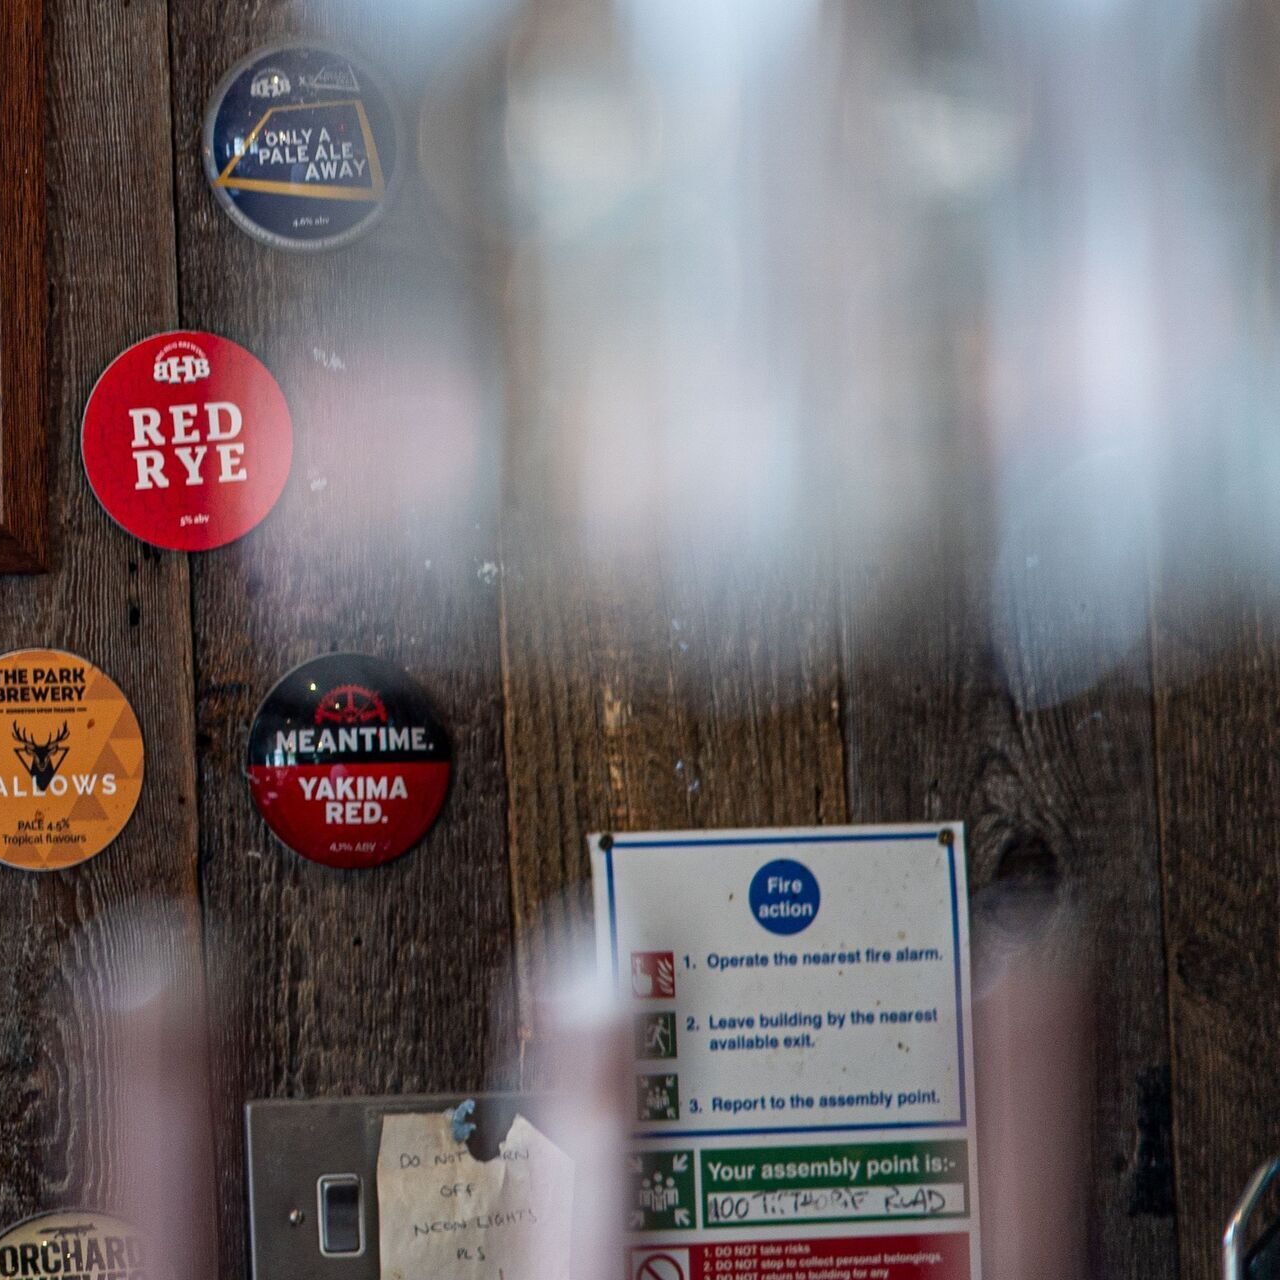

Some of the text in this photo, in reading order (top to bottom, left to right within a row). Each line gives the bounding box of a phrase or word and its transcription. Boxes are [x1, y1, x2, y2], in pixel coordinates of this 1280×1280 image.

[129, 401, 243, 448] RED
[132, 443, 247, 490] RYE
[33, 668, 85, 684] PARK
[276, 727, 434, 753] MEANTIME.
[298, 777, 408, 800] YAKIMA
[325, 803, 388, 825] RED.
[767, 877, 802, 894] Fire
[758, 901, 813, 919] action
[683, 947, 943, 972] 1. Operate the nearest fire alarm.
[707, 1161, 754, 1181] Your
[761, 1157, 859, 1181] assembly
[867, 1156, 918, 1178] point
